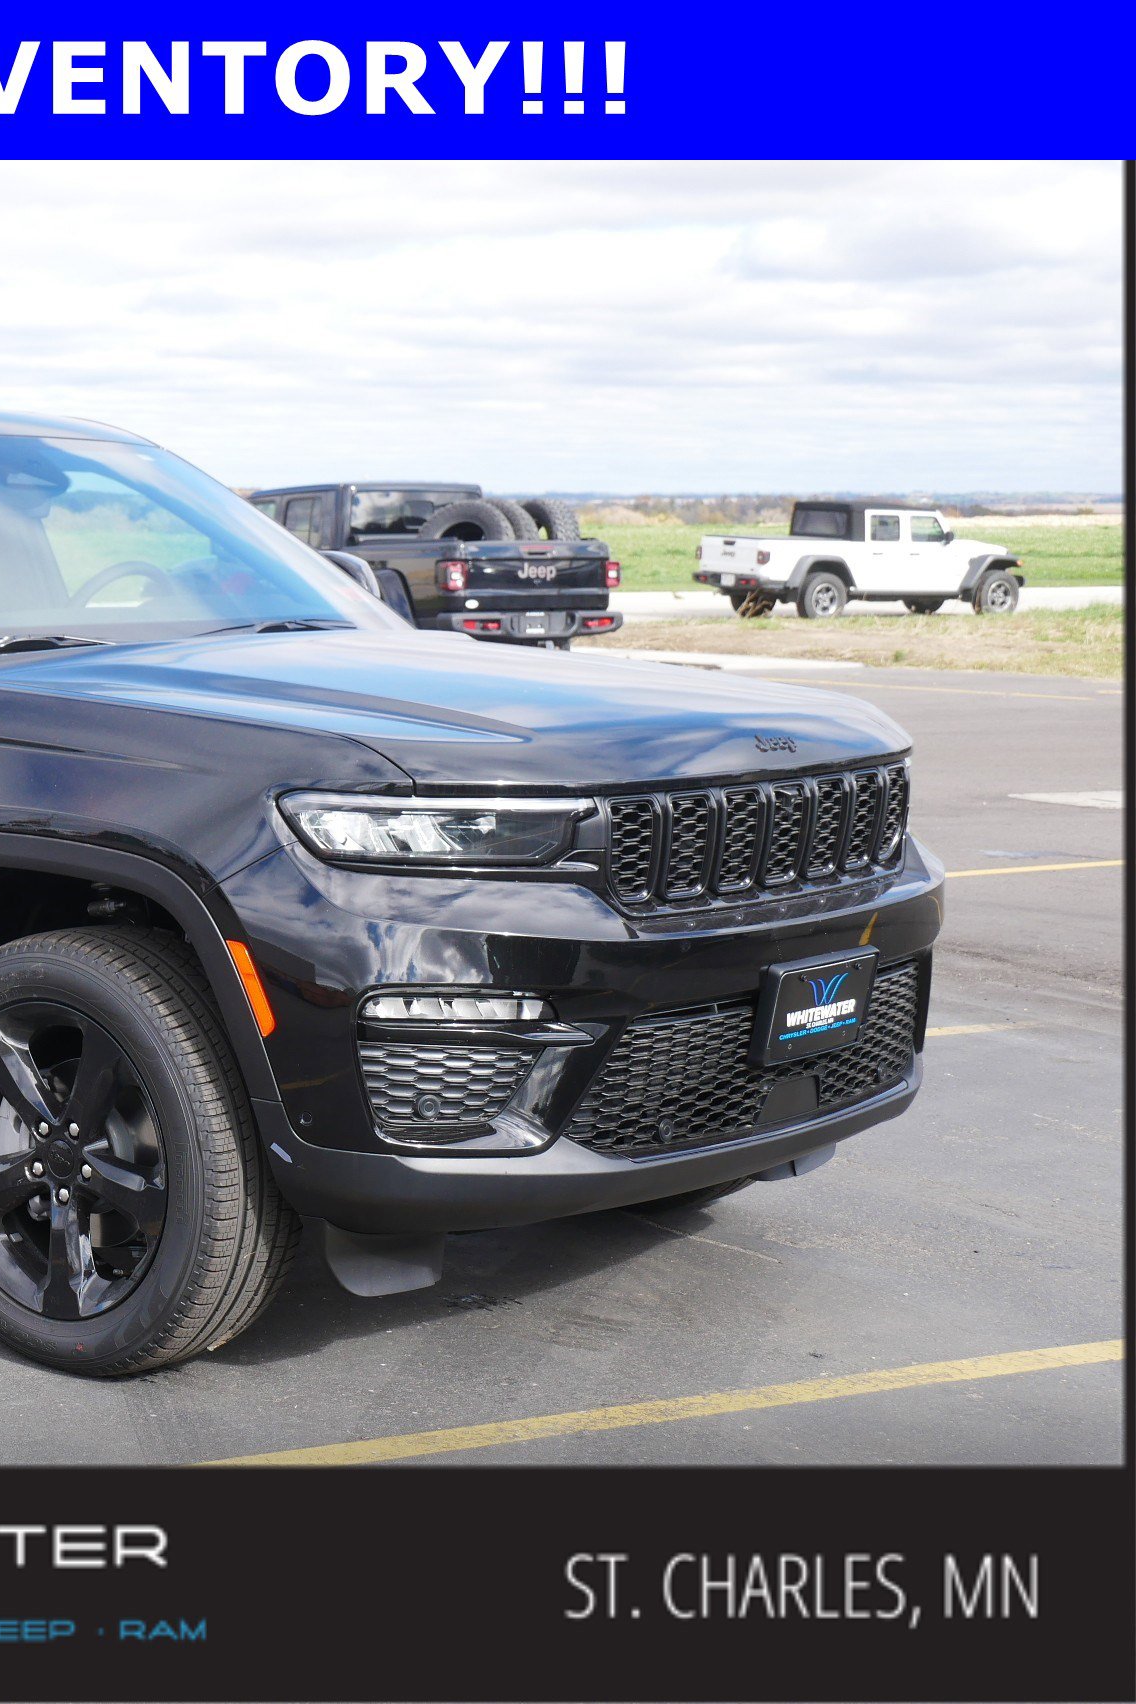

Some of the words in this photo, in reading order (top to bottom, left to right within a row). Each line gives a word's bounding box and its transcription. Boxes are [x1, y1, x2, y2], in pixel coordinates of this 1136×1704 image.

[517, 562, 557, 581] Jeep
[786, 998, 856, 1028] WHITEWATER
[779, 1029, 807, 1041] CHRYSLER
